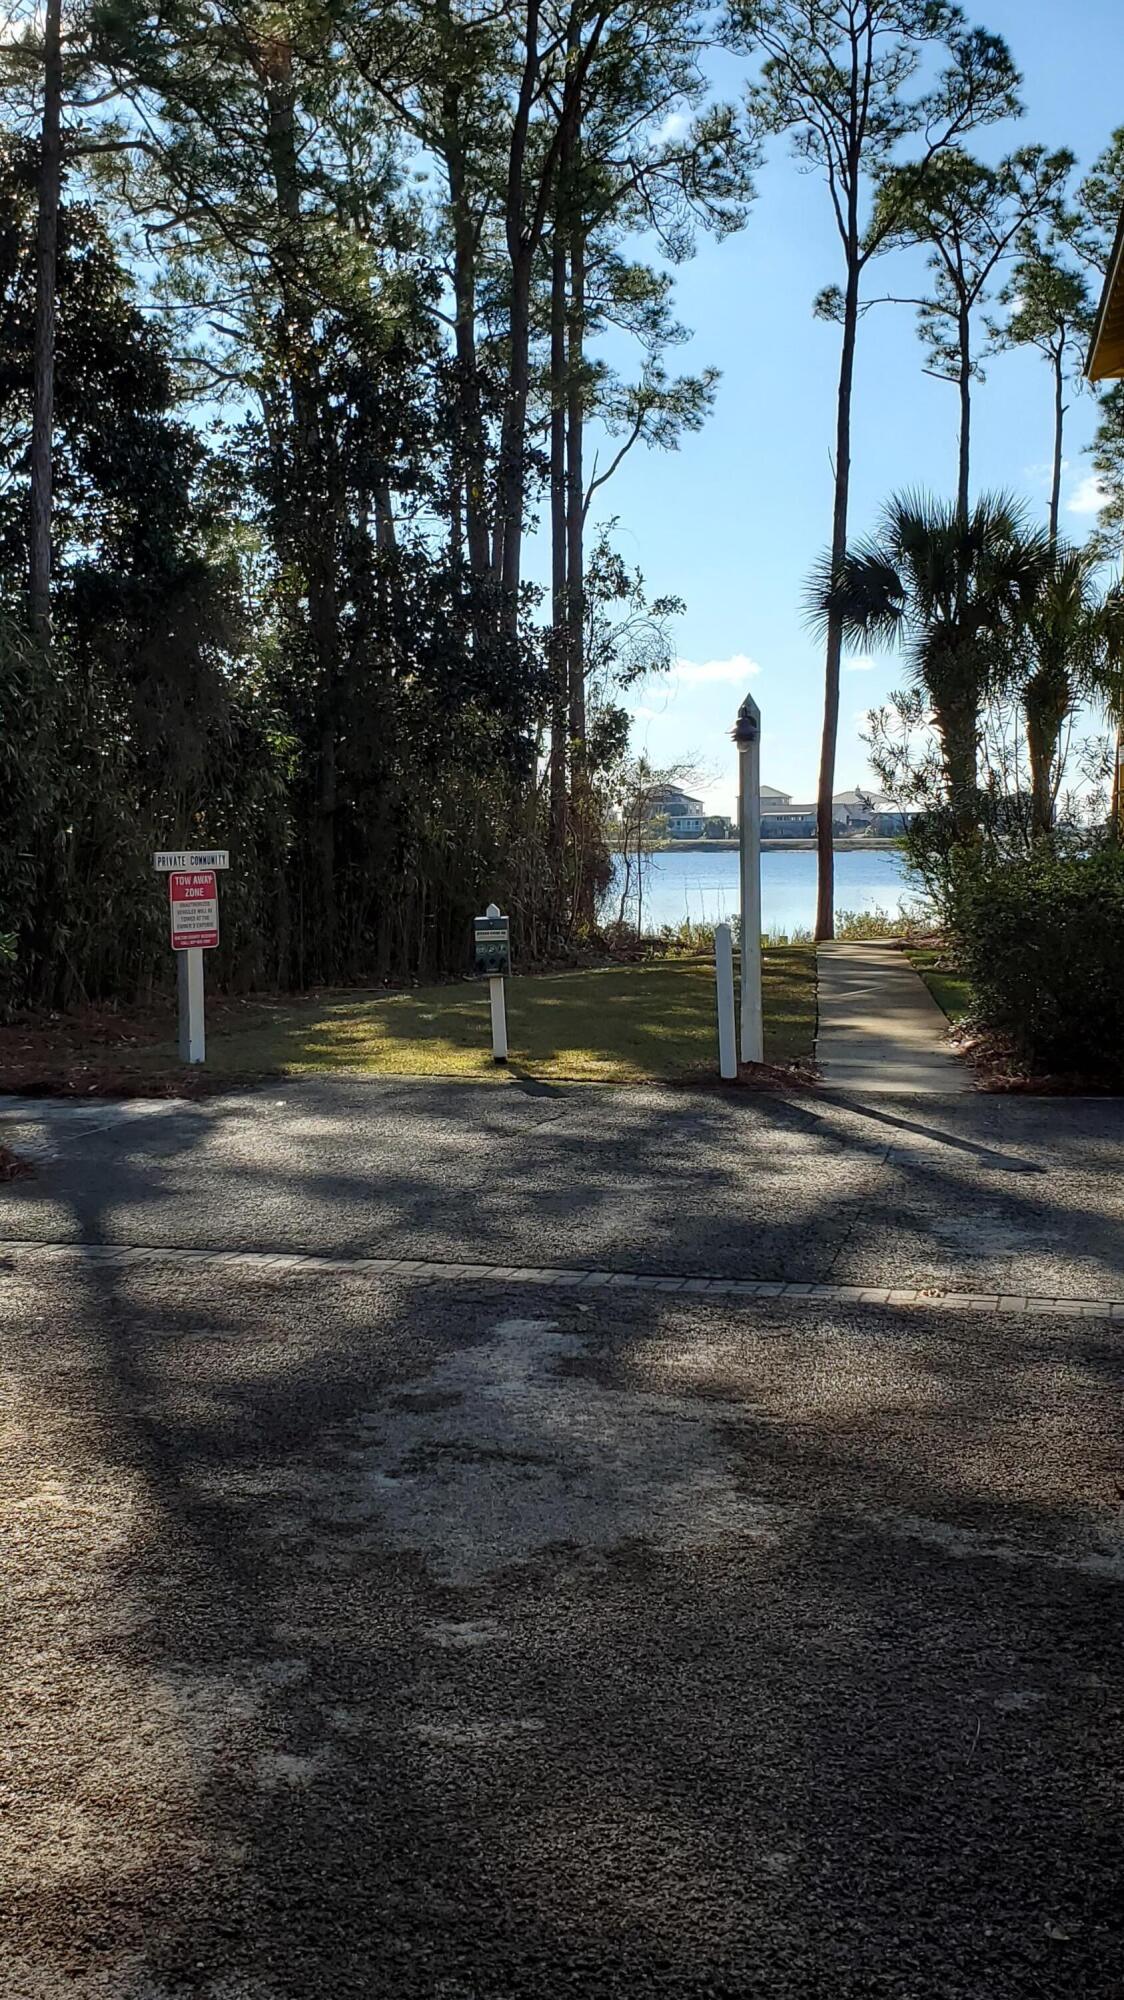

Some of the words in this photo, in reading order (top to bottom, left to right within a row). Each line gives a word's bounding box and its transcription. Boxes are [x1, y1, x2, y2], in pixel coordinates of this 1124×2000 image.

[157, 856, 186, 867] PRIVATE
[190, 854, 226, 865] COMMUNITY
[175, 876, 191, 886] TOW
[193, 875, 212, 885] AWAY
[185, 888, 204, 897] ZONE
